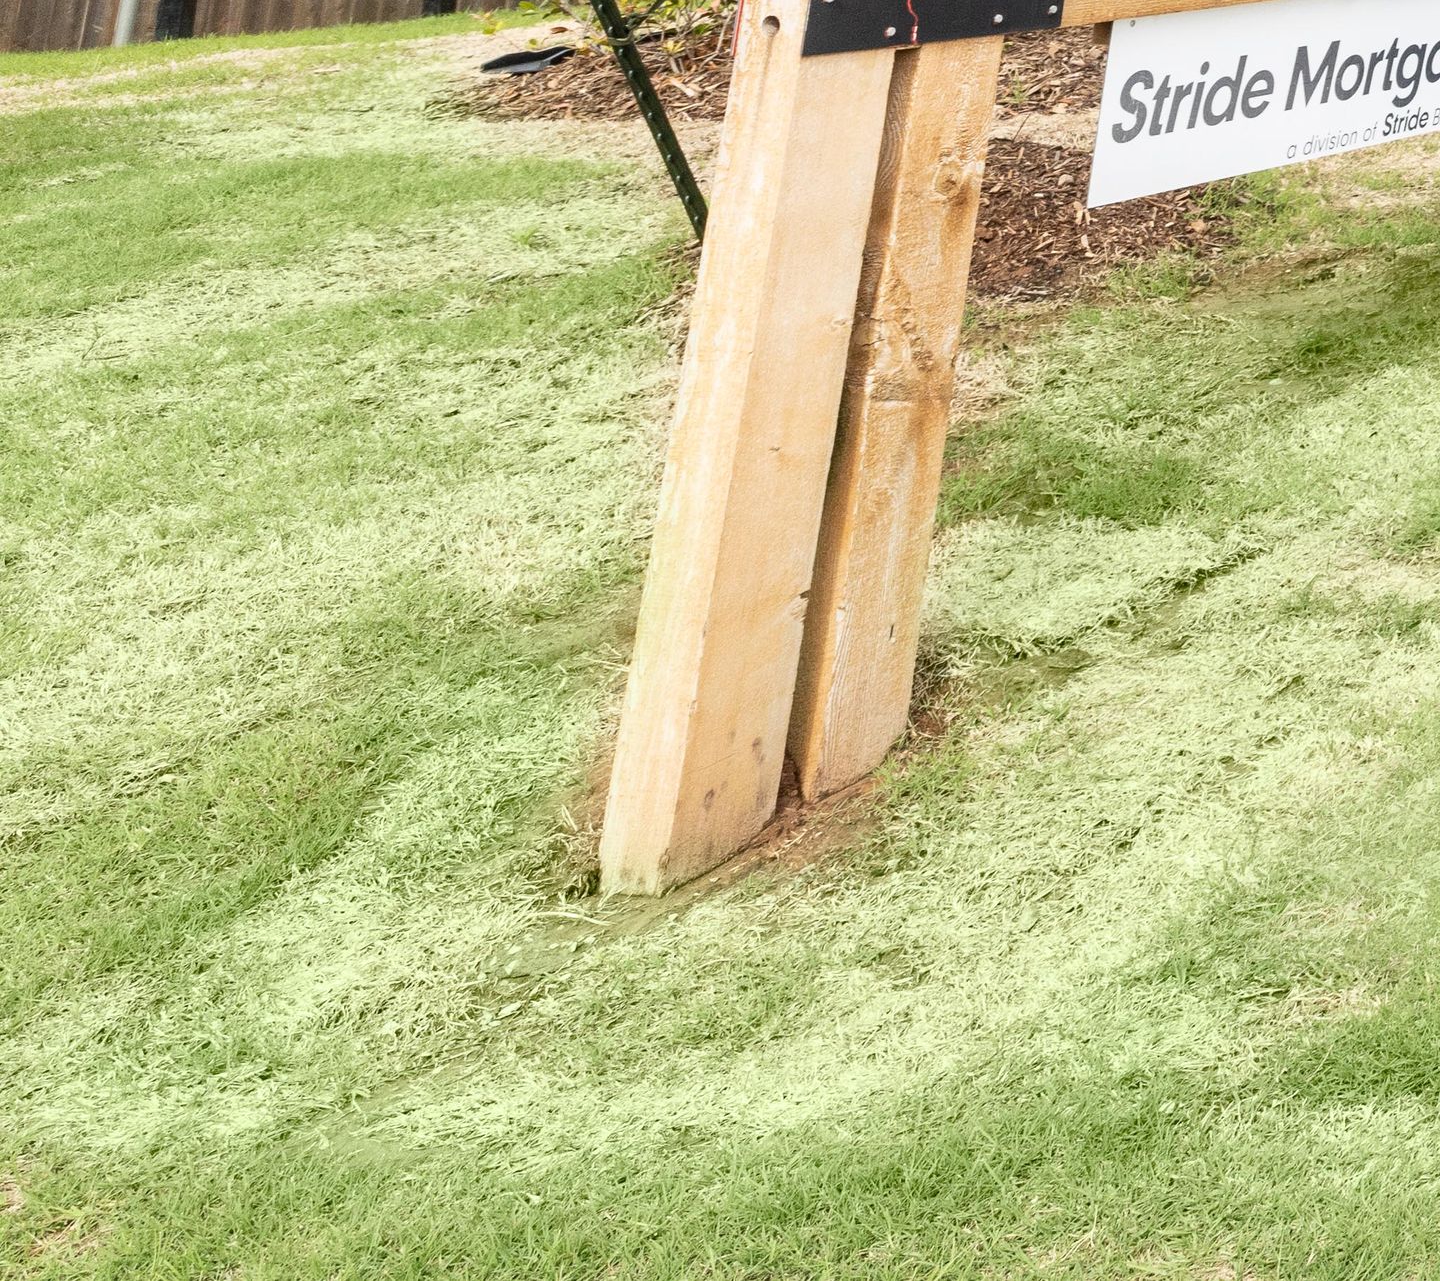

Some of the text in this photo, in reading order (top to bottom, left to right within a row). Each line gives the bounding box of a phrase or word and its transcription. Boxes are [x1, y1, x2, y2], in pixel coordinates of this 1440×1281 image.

[1112, 54, 1275, 144] Stride
[1286, 144, 1297, 159] a
[1303, 129, 1358, 156] division
[1362, 121, 1378, 142] of
[1382, 107, 1430, 137] Stride
